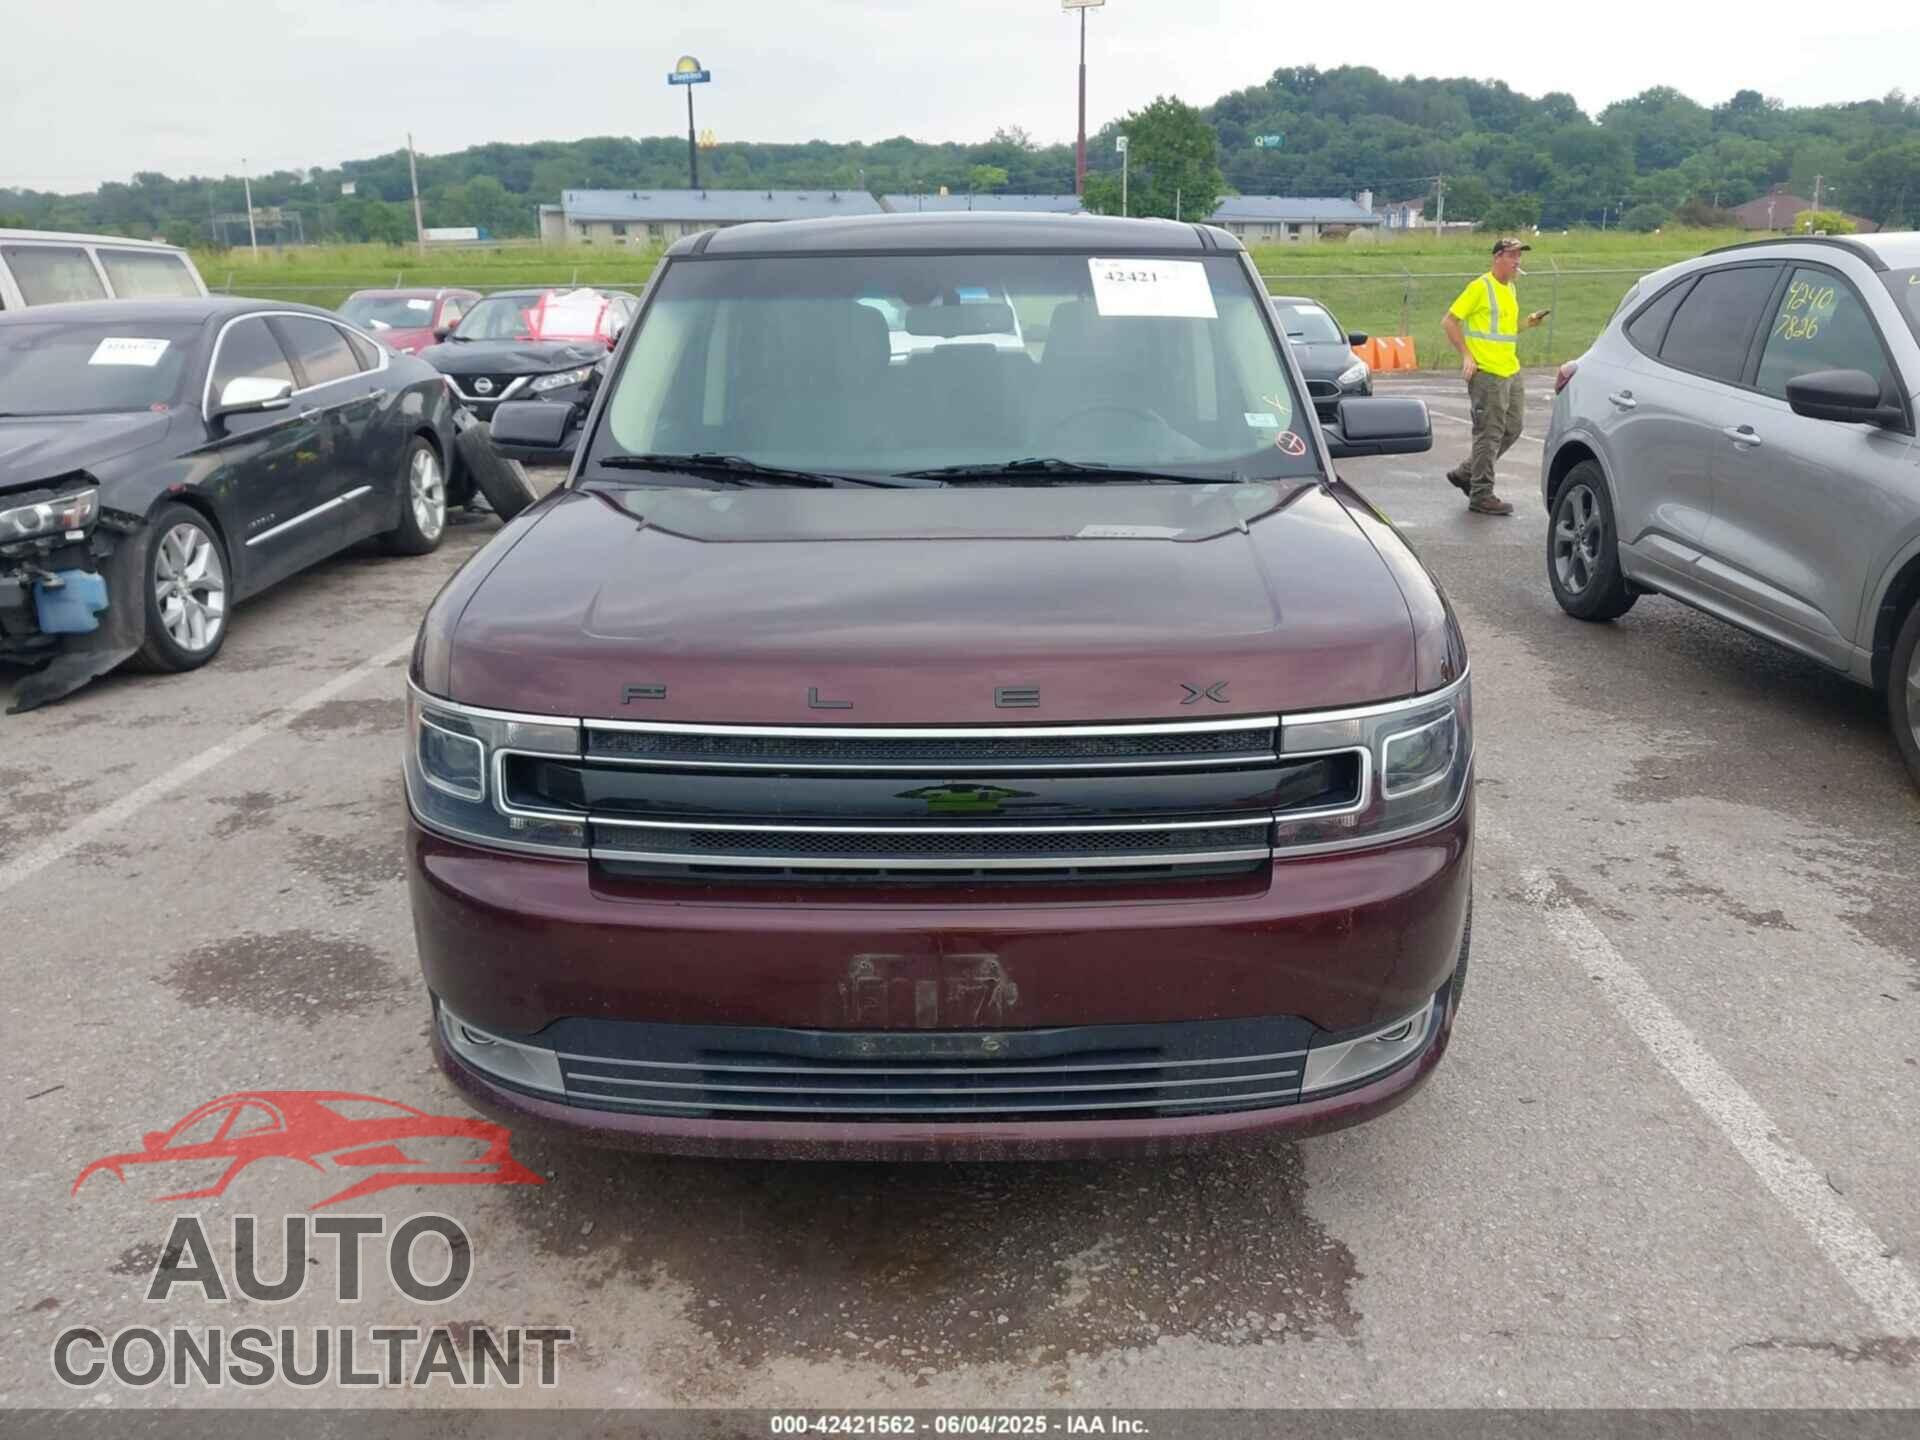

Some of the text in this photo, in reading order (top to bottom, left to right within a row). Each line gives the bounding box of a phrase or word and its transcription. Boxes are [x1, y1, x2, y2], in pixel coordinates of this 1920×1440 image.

[1787, 281, 1834, 310] 4240
[1775, 314, 1818, 340] 7826
[621, 680, 1230, 709] FLEX
